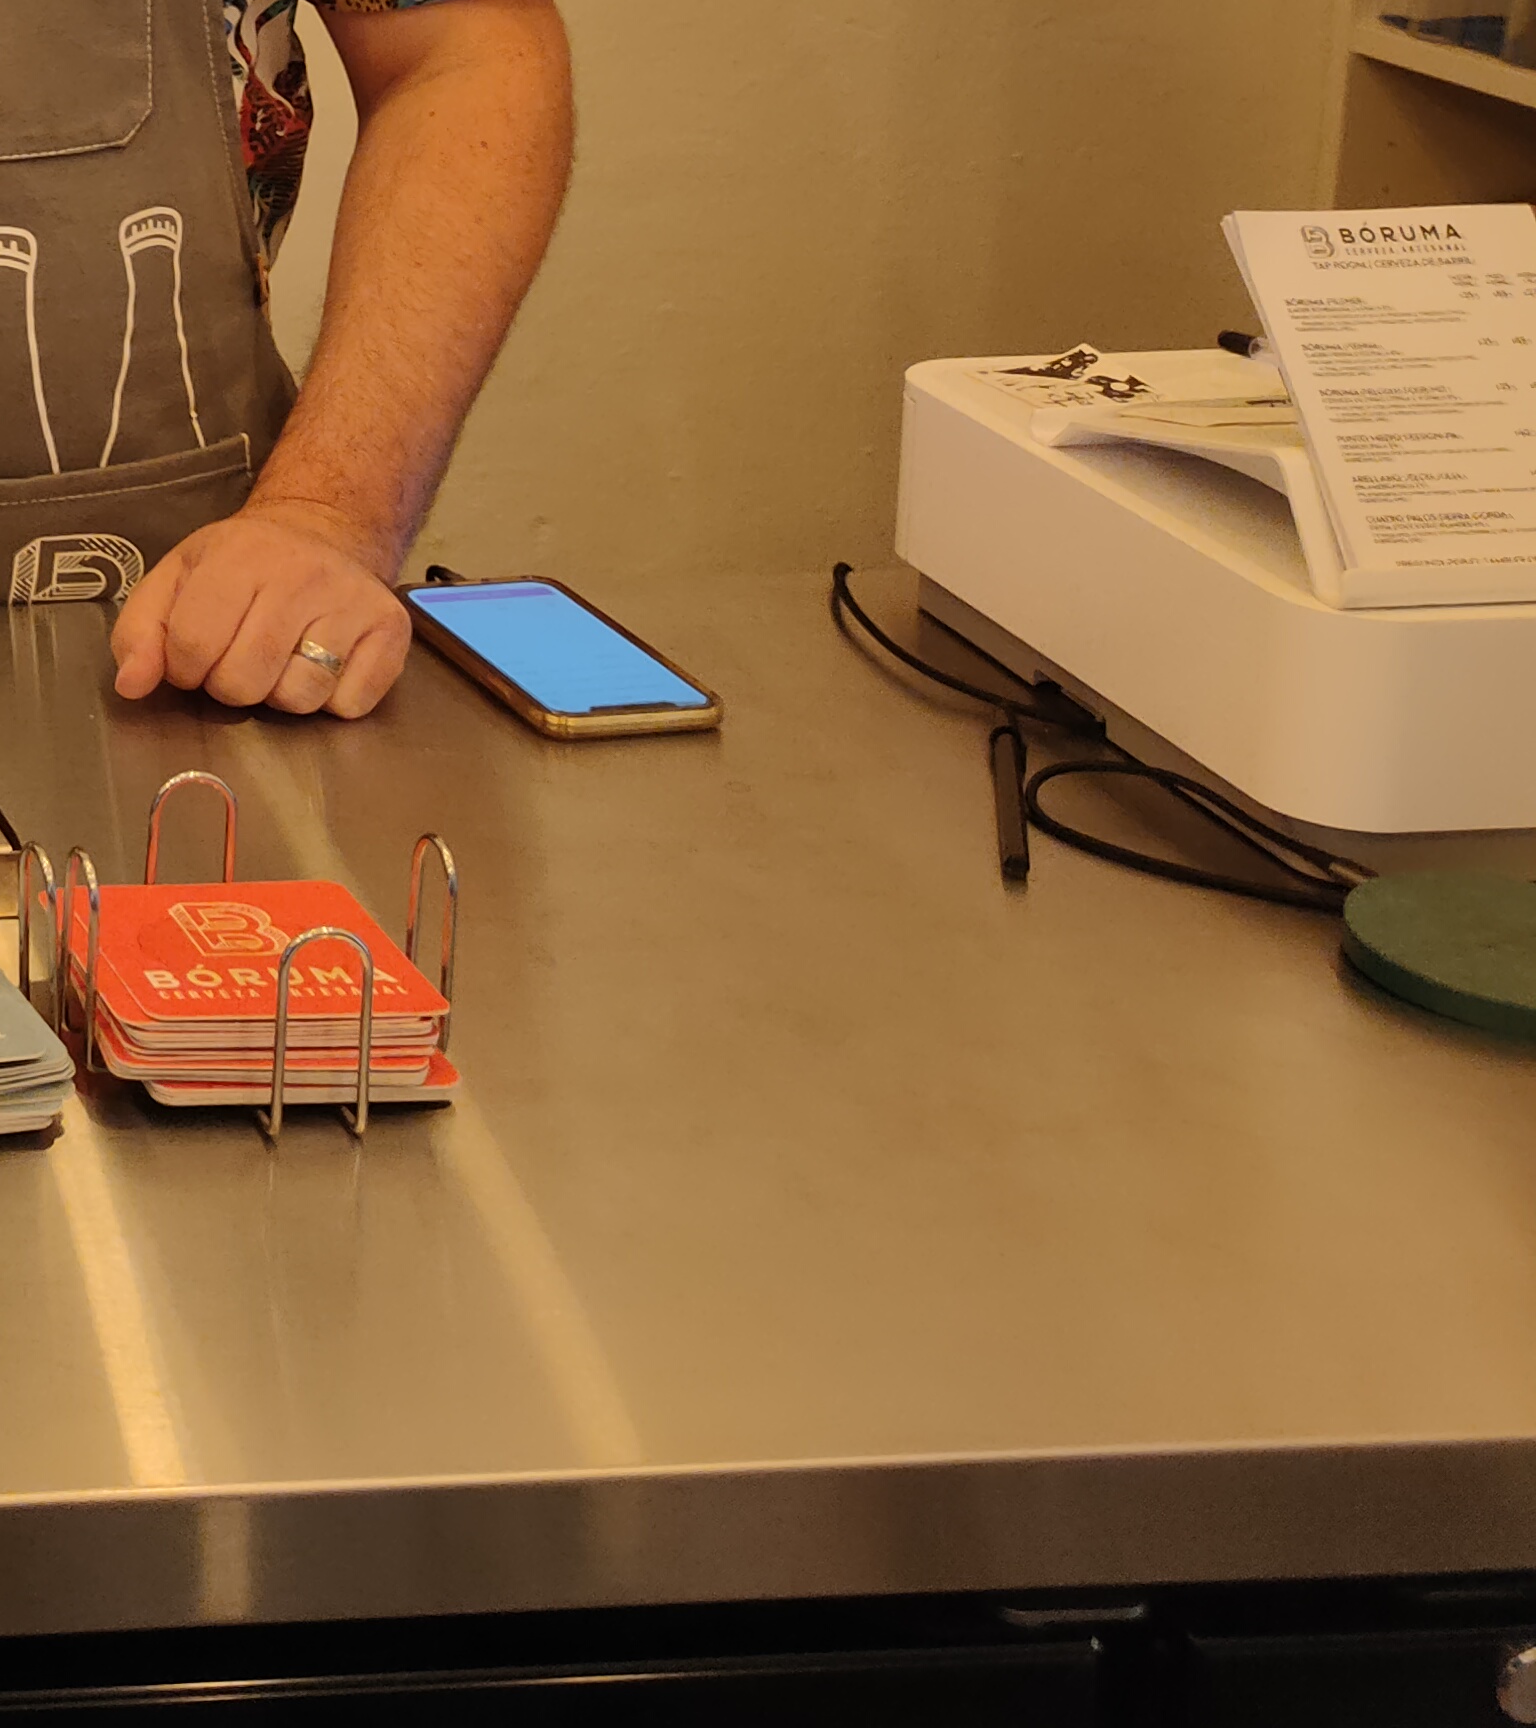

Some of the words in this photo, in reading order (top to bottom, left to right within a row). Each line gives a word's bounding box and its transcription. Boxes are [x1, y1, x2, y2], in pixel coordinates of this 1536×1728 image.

[1338, 222, 1462, 245] BÓRUMA
[1374, 258, 1419, 269] CERVEZA
[143, 964, 398, 989] BÓRUMA
[158, 988, 261, 1000] CERVEZA
